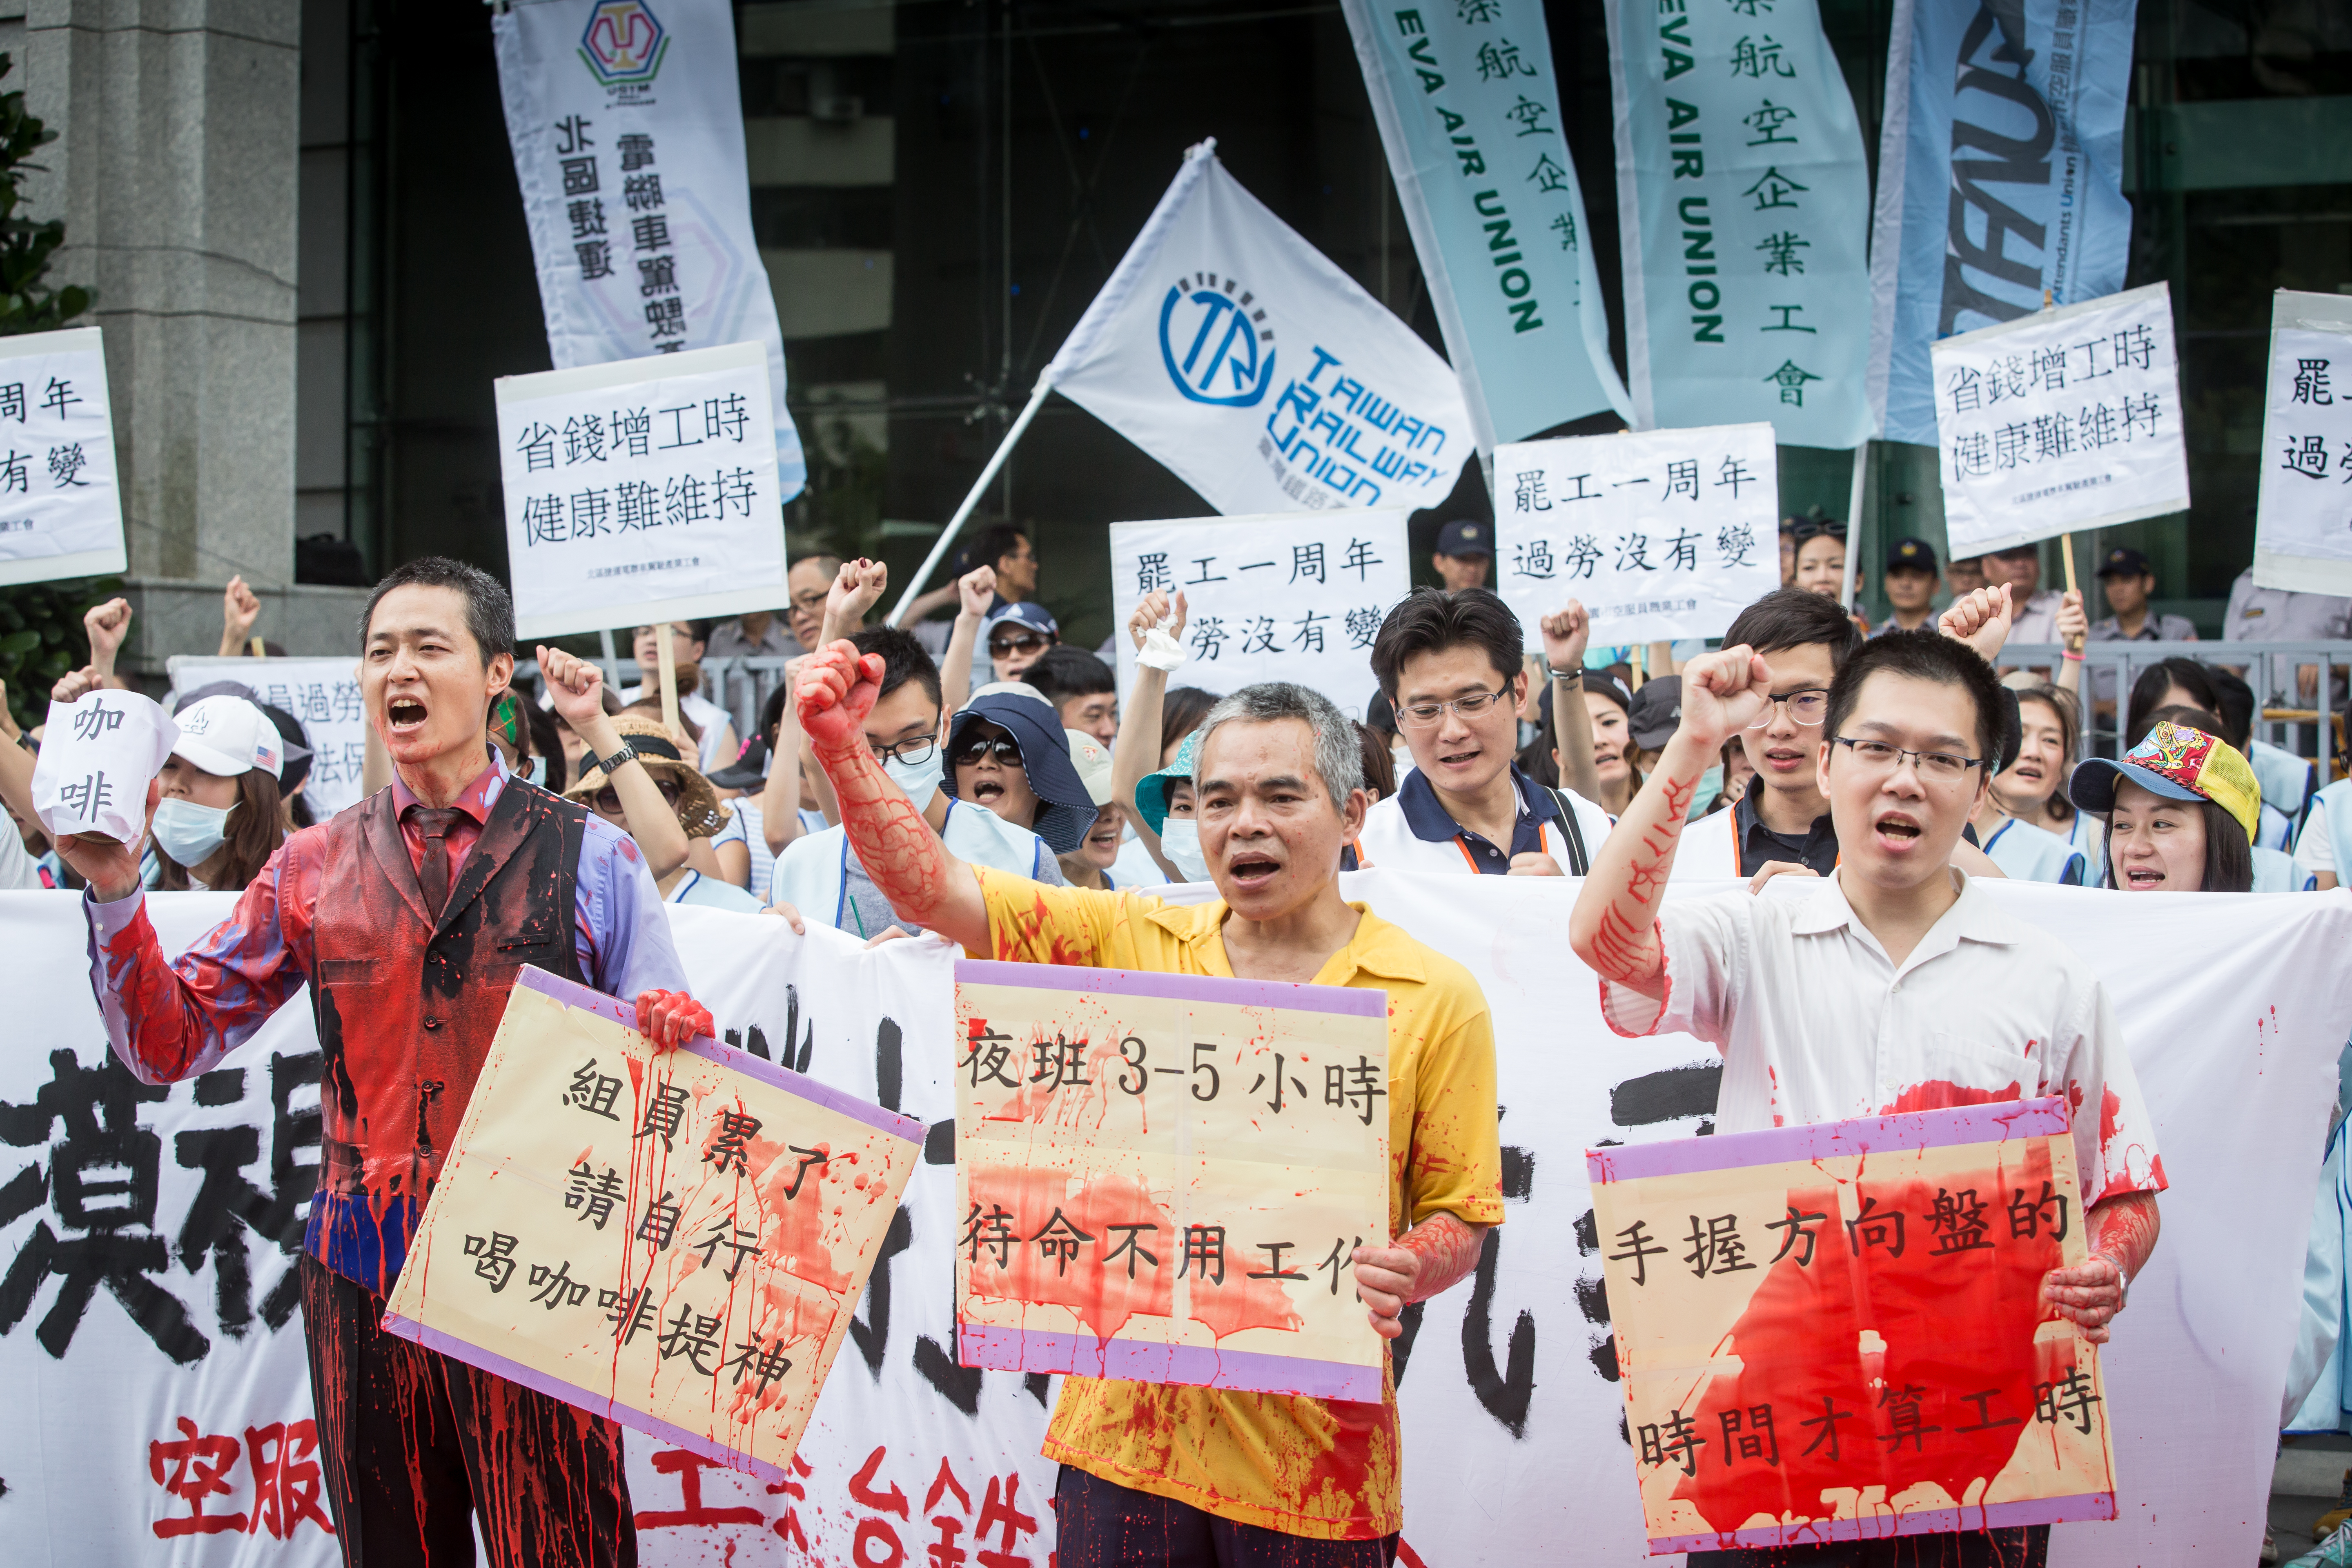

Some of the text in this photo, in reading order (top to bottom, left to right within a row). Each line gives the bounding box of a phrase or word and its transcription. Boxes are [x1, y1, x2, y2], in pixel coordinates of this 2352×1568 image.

[1394, 9, 1544, 334] EVA AIR UNION
[1659, 0, 1724, 344] EVA AIR UNION
[2061, 156, 2078, 207] Union
[0, 376, 83, 425] 周年
[1307, 345, 1446, 456] TAIWAN
[1947, 324, 2156, 414] 省錢增工時
[0, 442, 91, 493] 有變
[517, 392, 750, 473] 省錢增工時
[1267, 413, 1381, 506] UNION
[1275, 379, 1448, 487] RAILWAY
[1951, 392, 2162, 482] 健康難維持
[522, 467, 757, 548] 健康難維持
[1514, 454, 1756, 513] 罷工一周年
[1137, 537, 1383, 595] 罷工一周年
[1512, 522, 1757, 580] 過勞沒有變
[1191, 604, 1382, 661] 勞沒有變
[182, 705, 209, 735] LA
[252, 681, 365, 723] 員過勞
[60, 697, 125, 824] 咖啡
[562, 1058, 827, 1200] 組員累了
[565, 1162, 762, 1282] 請自行
[1608, 1180, 2069, 1287] 手握方向盤的
[463, 1231, 793, 1400] 喝咖啡提神
[1637, 1366, 2103, 1478] 時間才算工時
[149, 1415, 338, 1541] 空服
